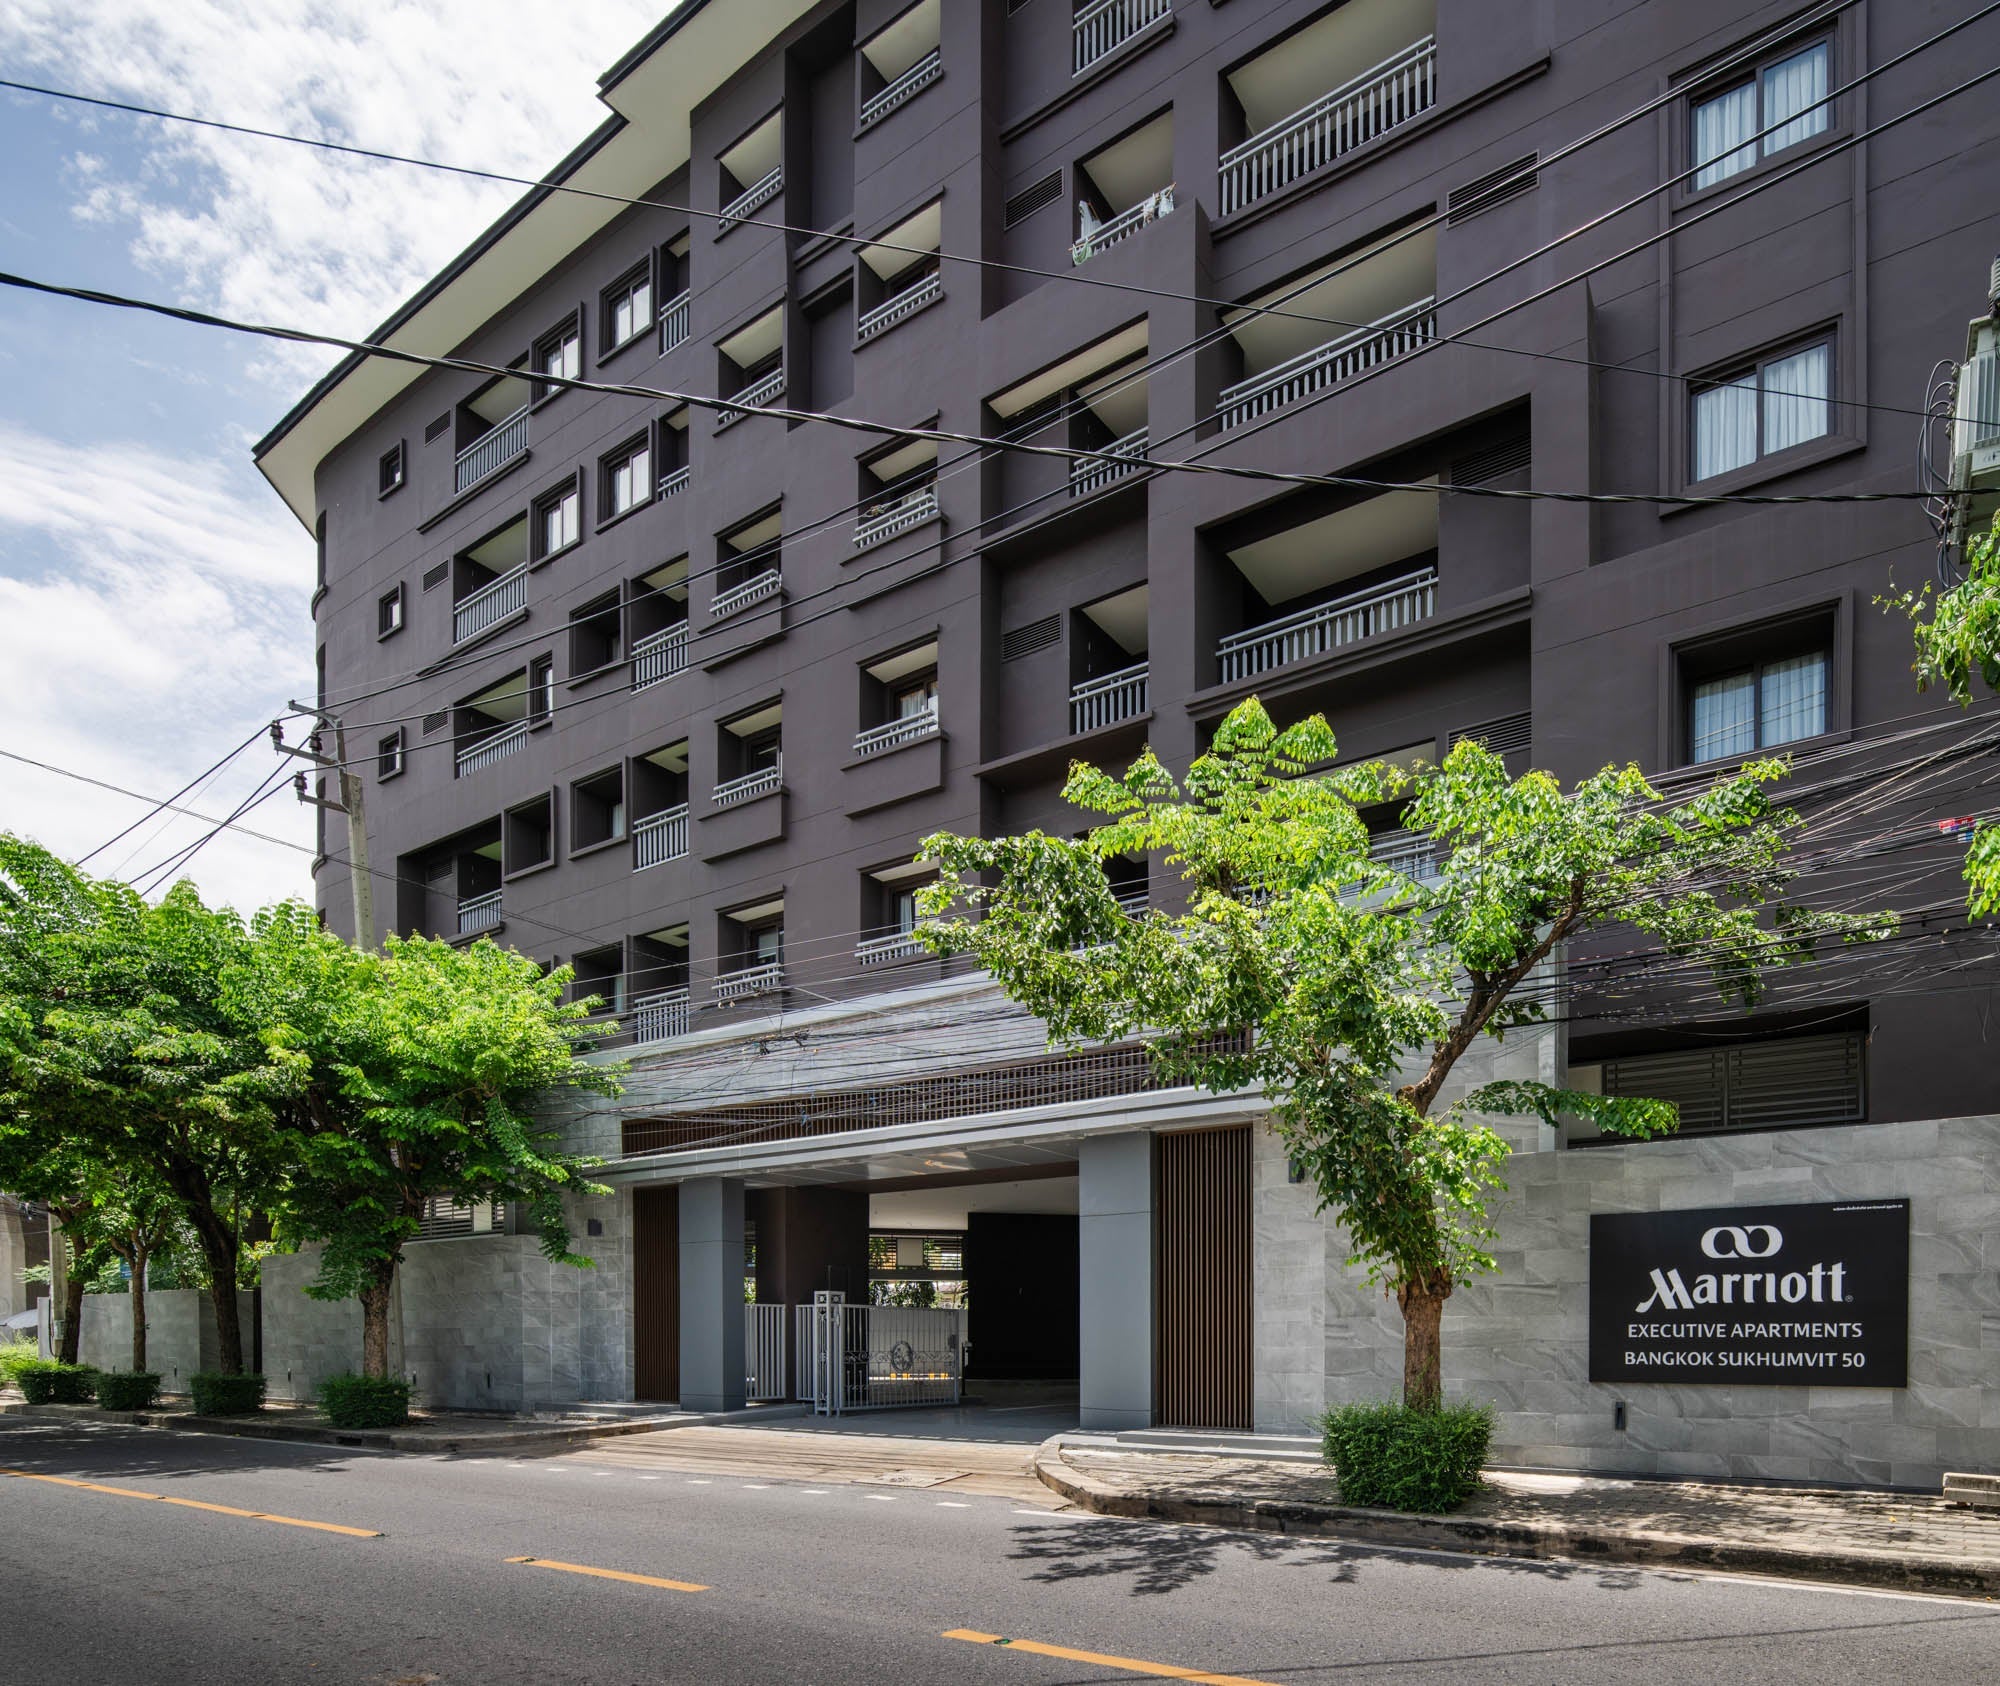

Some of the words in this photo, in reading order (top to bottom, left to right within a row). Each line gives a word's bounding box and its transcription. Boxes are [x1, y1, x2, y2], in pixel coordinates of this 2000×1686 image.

[1635, 1262, 1847, 1313] Marriott
[1628, 1324, 1727, 1338] EXECUTIVE
[1730, 1323, 1863, 1338] APARTMENTS
[1624, 1351, 1714, 1366] BANGKOK
[1717, 1352, 1838, 1368] SUKHUMVIT
[1842, 1352, 1866, 1368] 50
